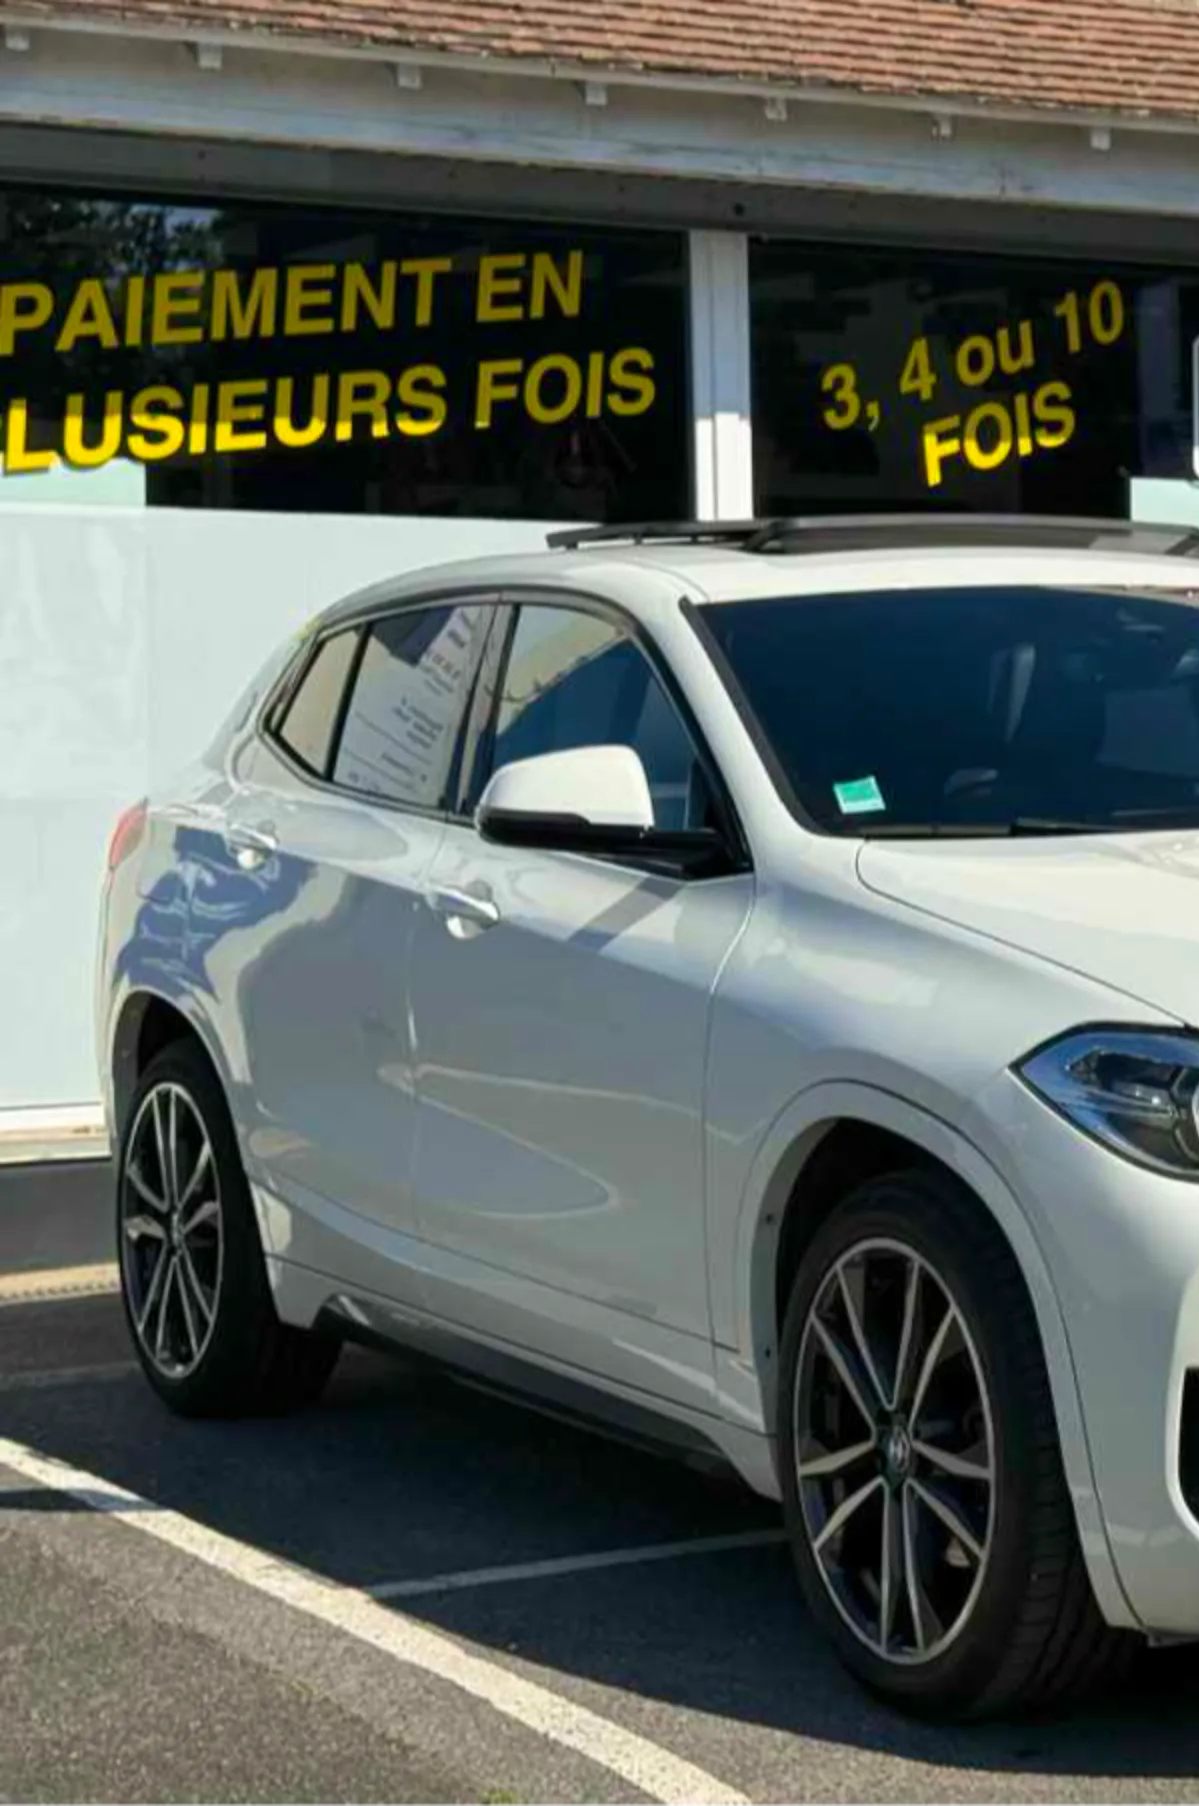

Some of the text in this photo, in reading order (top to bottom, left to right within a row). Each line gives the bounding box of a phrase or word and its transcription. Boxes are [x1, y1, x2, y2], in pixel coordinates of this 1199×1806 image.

[0, 252, 584, 355] PAIEMENT EN
[820, 280, 1125, 432] 3, 4 ou 10
[0, 347, 656, 472] LUSIEURS FOIS
[922, 381, 1076, 487] FOIS
